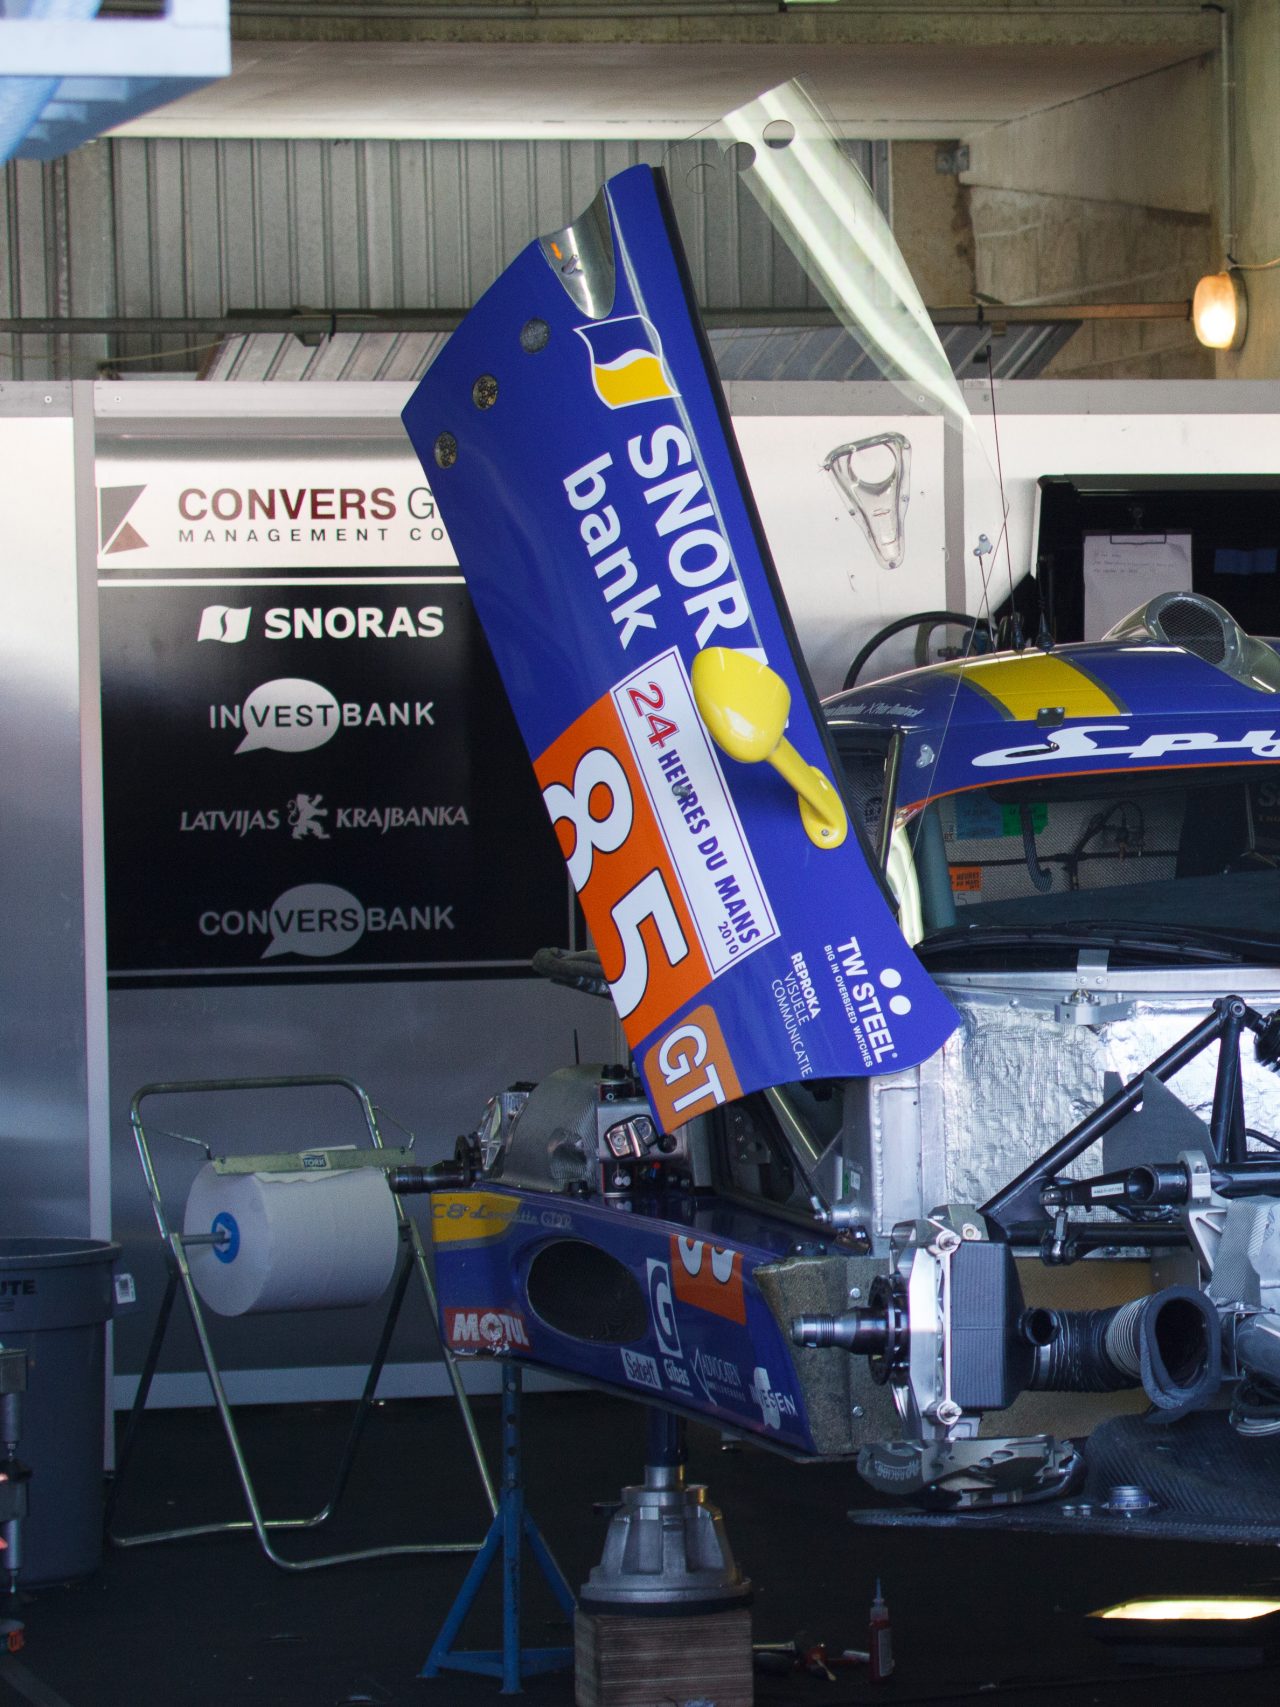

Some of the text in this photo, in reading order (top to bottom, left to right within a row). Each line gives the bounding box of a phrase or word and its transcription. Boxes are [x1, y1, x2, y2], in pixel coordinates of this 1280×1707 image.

[178, 488, 397, 521] CONVERS
[179, 528, 389, 543] MANAGEMENT
[563, 452, 662, 649] bank
[627, 424, 769, 670] SNOR
[264, 607, 444, 639] SNORAS
[210, 702, 435, 729] INVESTBANK
[180, 806, 470, 834] LATVIJAS KRAJBANKA
[627, 681, 763, 945] 24 HEURES DU MANS
[543, 747, 690, 1019] 85
[199, 906, 455, 937] CONVERSBANK
[717, 920, 740, 956] 2010
[784, 970, 811, 1026] VISUELE
[790, 952, 821, 1019] REPROKA
[824, 945, 874, 1068] BIG IN OVERSIZED WATCHES
[837, 936, 895, 1064] TW STEEL
[771, 978, 813, 1078] COMMUNICATIE
[658, 1023, 727, 1113] GT
[453, 1312, 529, 1347] MOTUL
[624, 1351, 659, 1387] Sabelt
